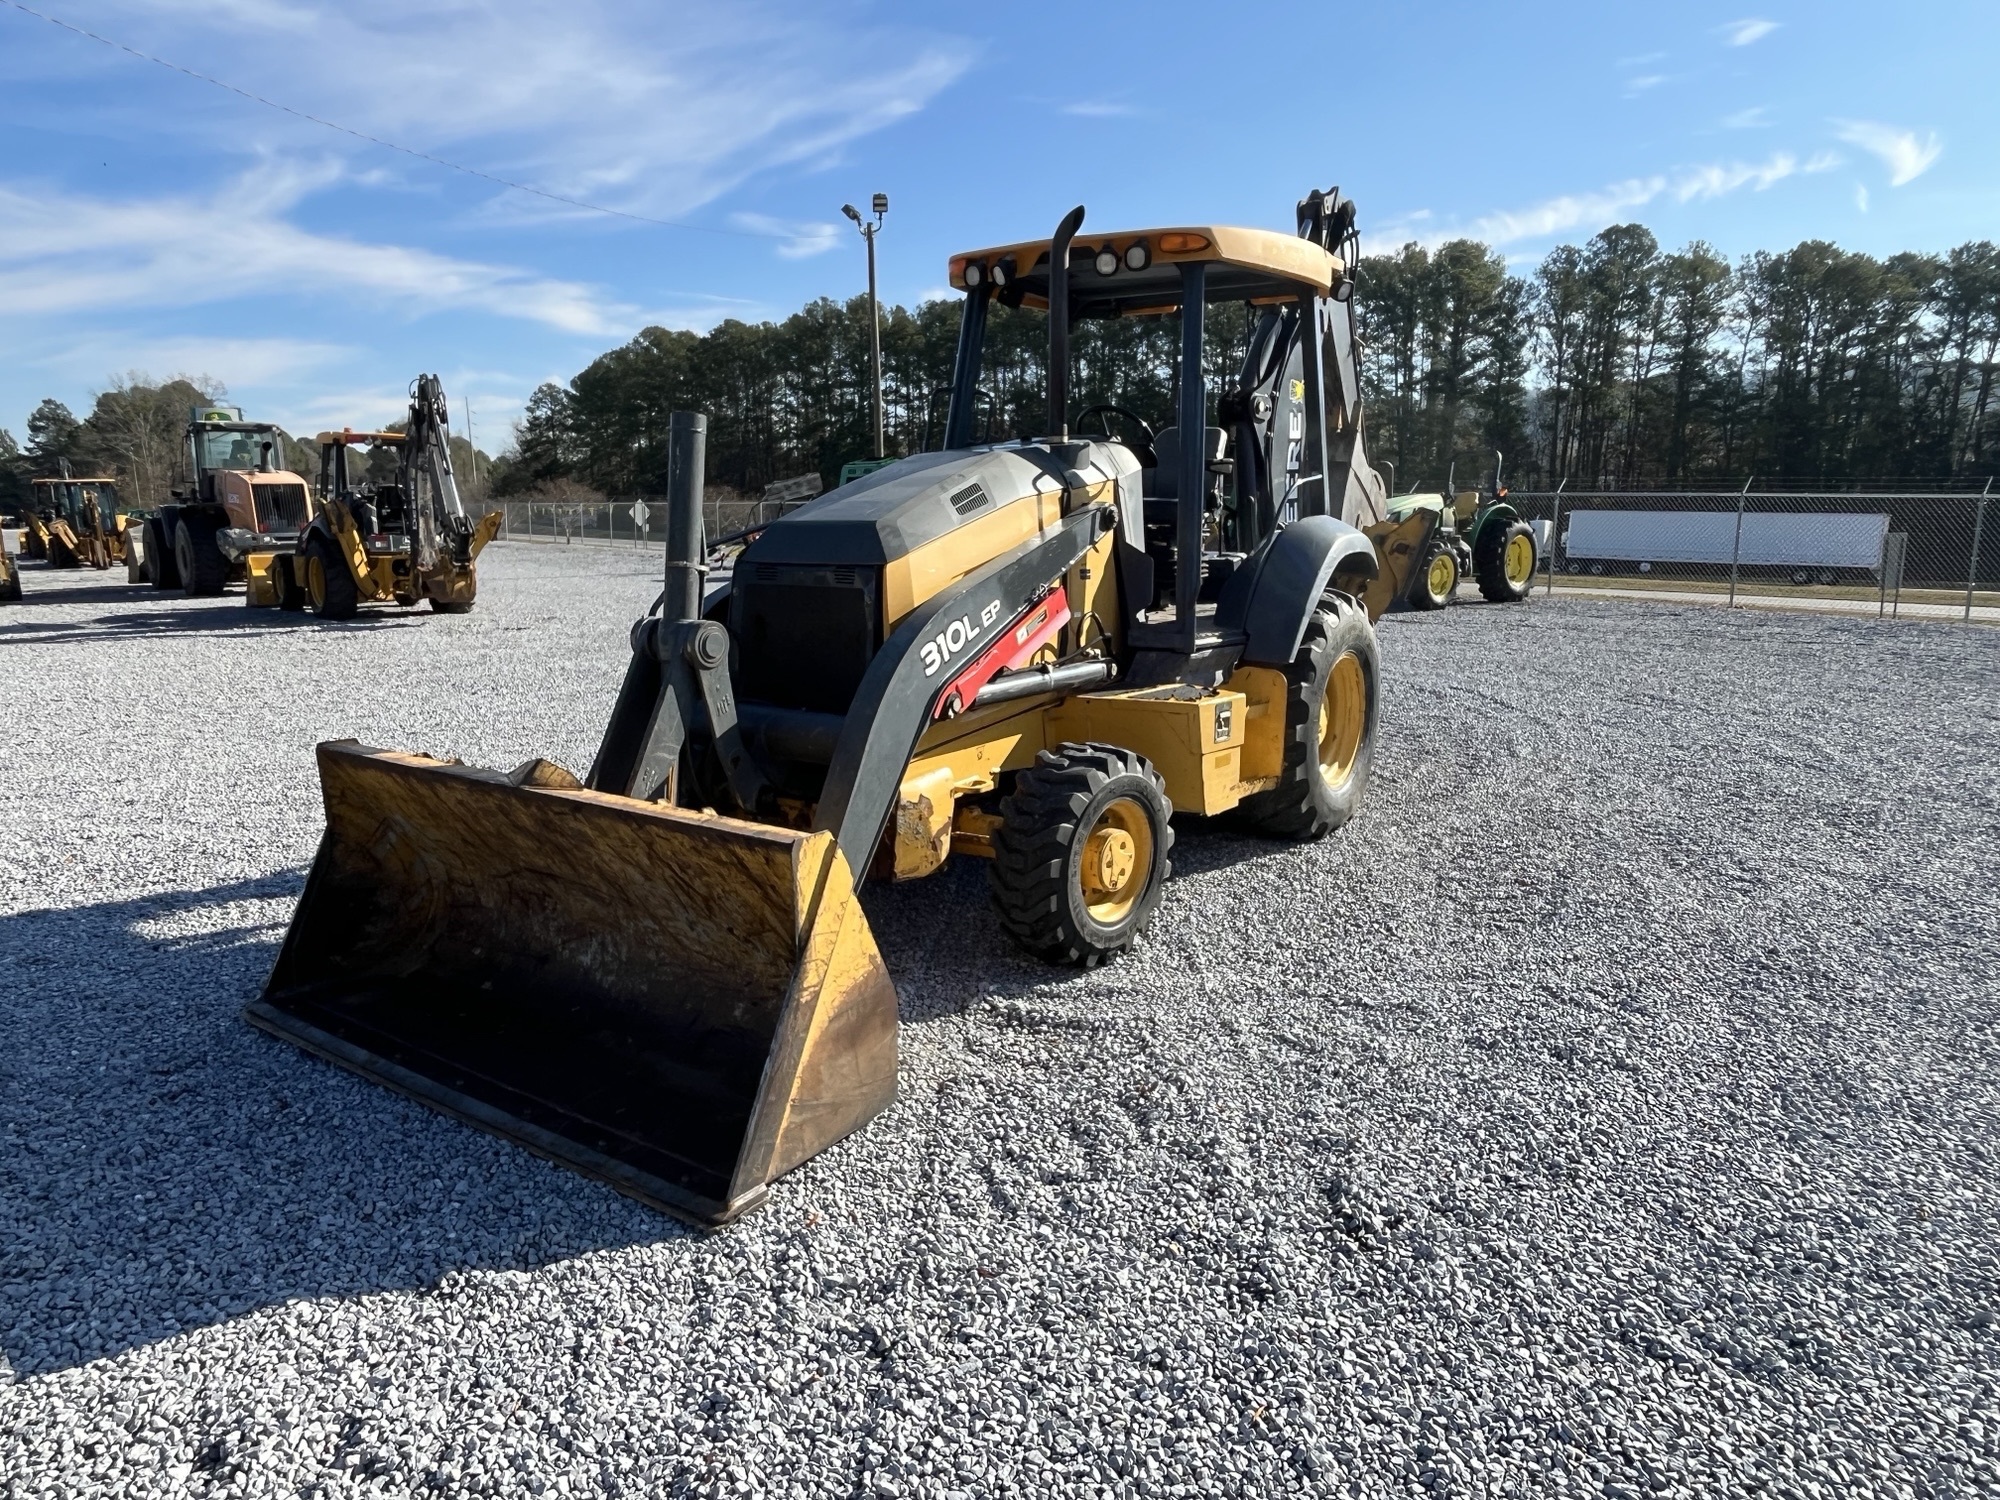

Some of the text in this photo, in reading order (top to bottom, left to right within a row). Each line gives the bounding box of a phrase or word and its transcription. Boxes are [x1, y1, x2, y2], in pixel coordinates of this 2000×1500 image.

[1285, 412, 1302, 523] EERE
[920, 599, 1001, 677] 310L EP
